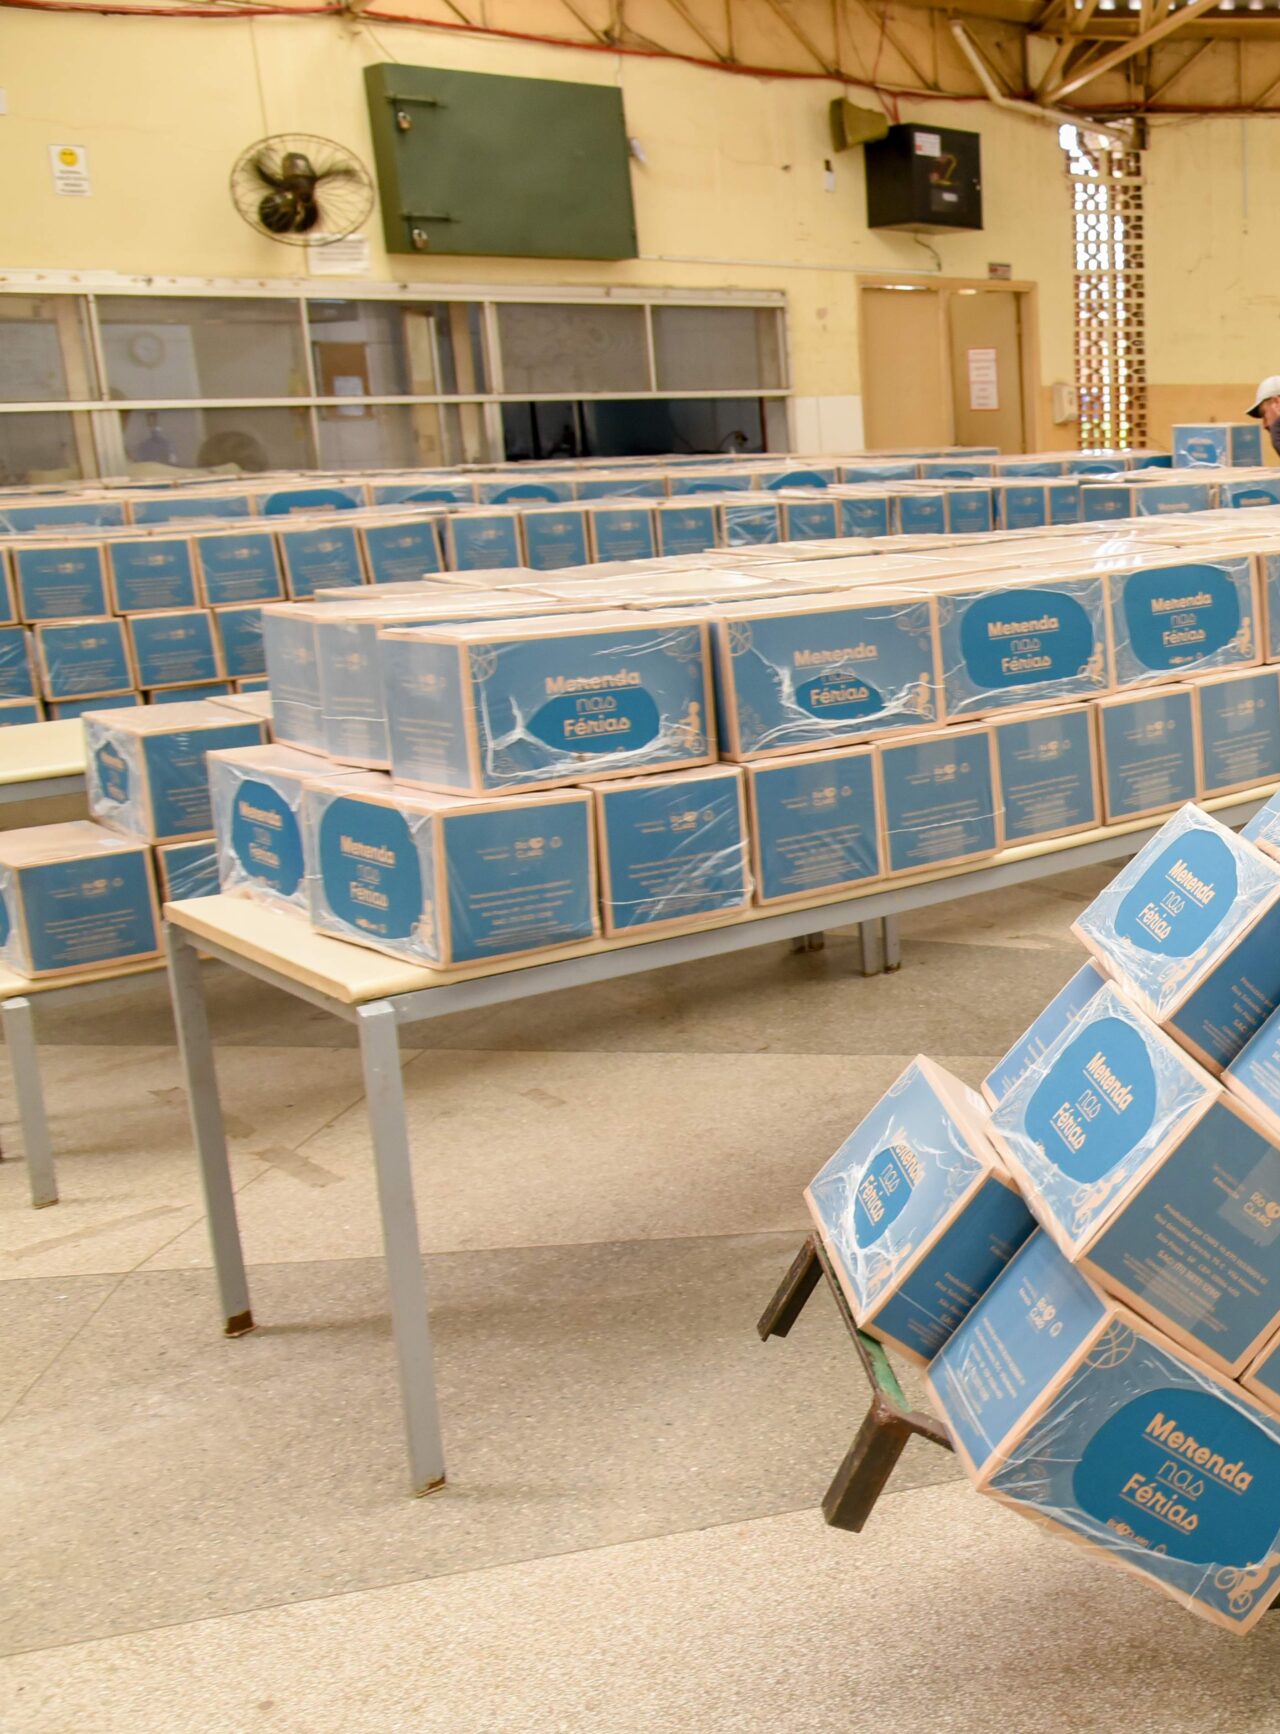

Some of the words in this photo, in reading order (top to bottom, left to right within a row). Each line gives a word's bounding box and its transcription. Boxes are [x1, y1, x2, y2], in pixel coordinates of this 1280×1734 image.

[1151, 592, 1212, 612] Merenda
[988, 615, 1060, 636] Merenda
[1171, 613, 1197, 625] nas
[1011, 638, 1040, 651] nas
[1163, 628, 1205, 644] Férias
[794, 642, 878, 666] Merenda
[1002, 654, 1052, 672] Férias
[545, 669, 641, 694] Merenda
[576, 696, 616, 712] nas
[810, 685, 870, 705] Férias
[564, 715, 631, 736] Férias
[1169, 860, 1215, 904] Merenda
[1162, 891, 1185, 913] nas
[1139, 902, 1171, 939] Férias
[1086, 1052, 1134, 1111] Merenda
[1079, 1090, 1101, 1118] nas
[1053, 1102, 1087, 1149] Férias
[881, 1164, 899, 1192] nas
[859, 1174, 885, 1222] Férias
[1146, 1412, 1253, 1491] Merenda
[1159, 1459, 1204, 1497] nas
[1122, 1474, 1199, 1531] Férias
